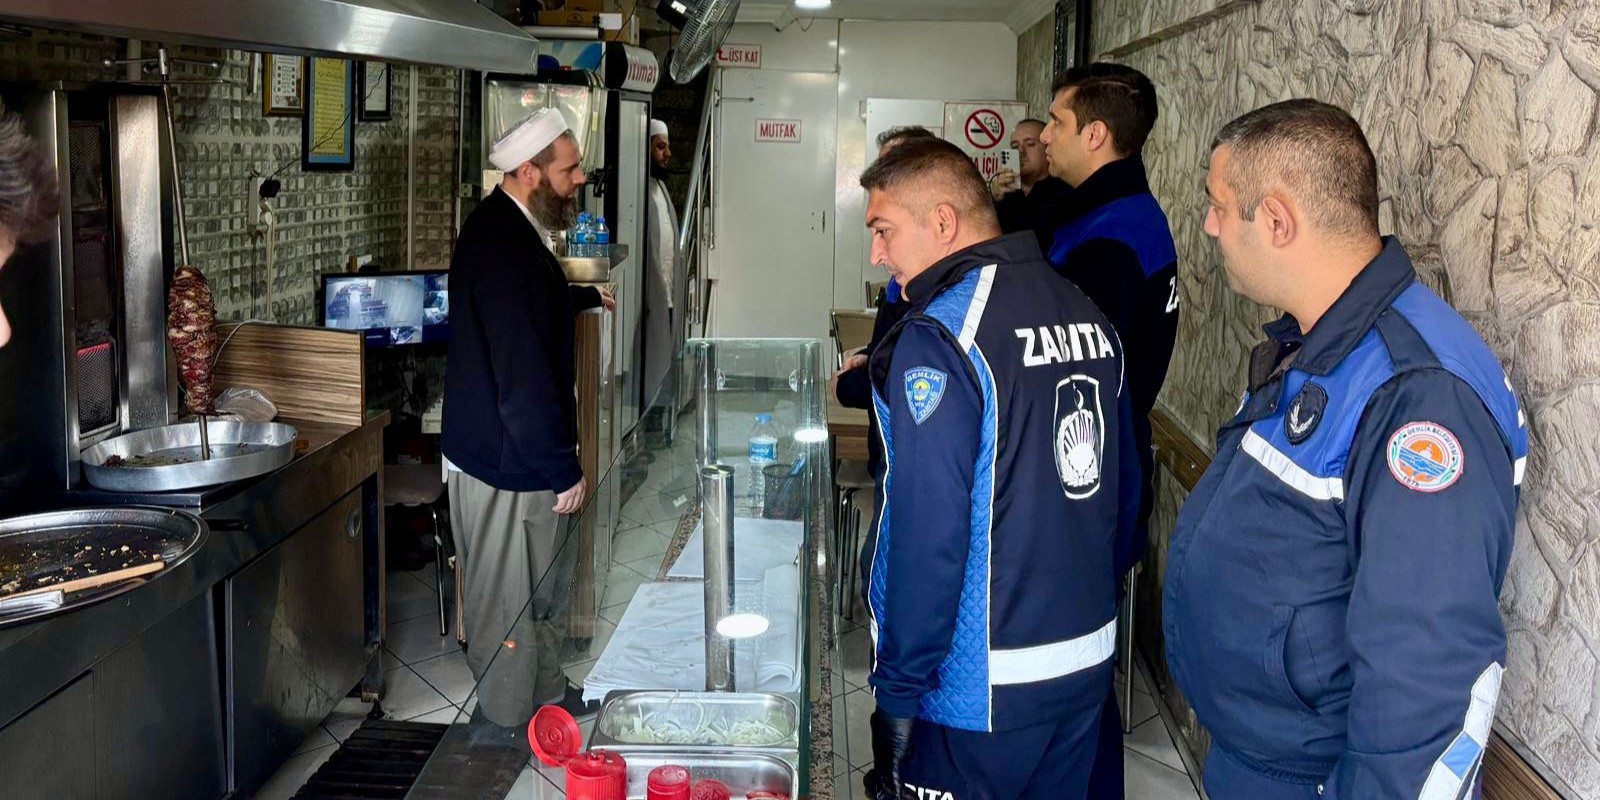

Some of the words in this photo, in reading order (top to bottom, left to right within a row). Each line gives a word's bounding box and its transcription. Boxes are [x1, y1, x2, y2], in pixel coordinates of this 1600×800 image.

[728, 47, 743, 62] ÜST
[744, 50, 759, 63] KAT
[760, 122, 797, 139] MUTFAK
[1014, 322, 1115, 368] ZABITA
